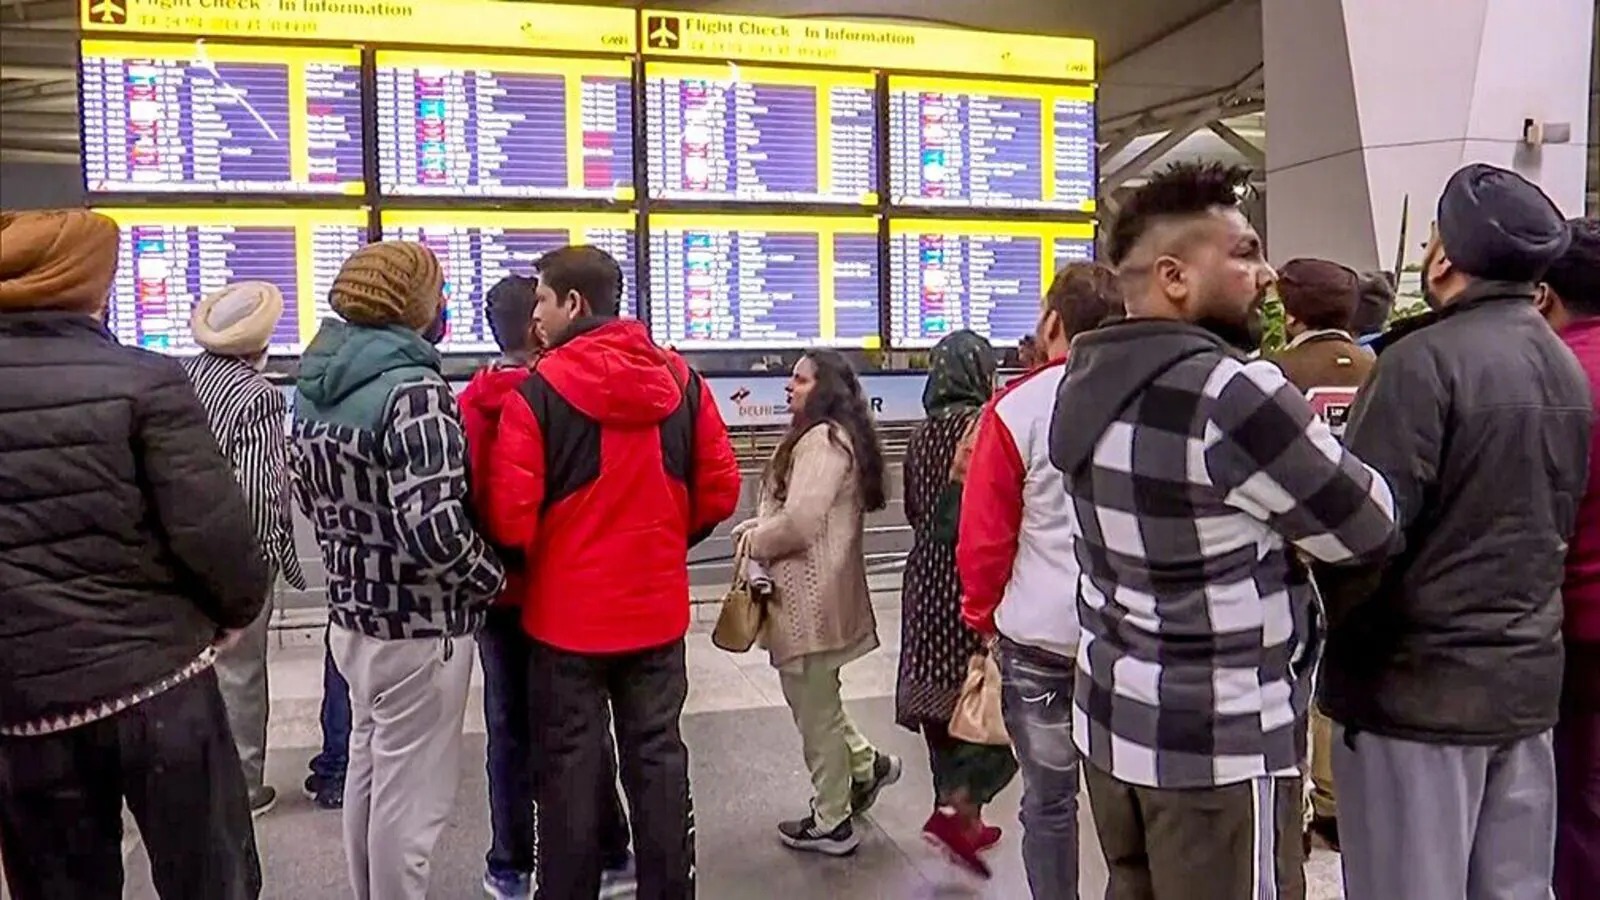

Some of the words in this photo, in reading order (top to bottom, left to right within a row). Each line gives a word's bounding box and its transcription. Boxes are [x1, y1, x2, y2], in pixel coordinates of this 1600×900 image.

[302, 0, 413, 16] Information
[685, 18, 733, 34] Flight
[739, 21, 790, 37] Check
[804, 26, 820, 39] In
[824, 27, 916, 45] Information
